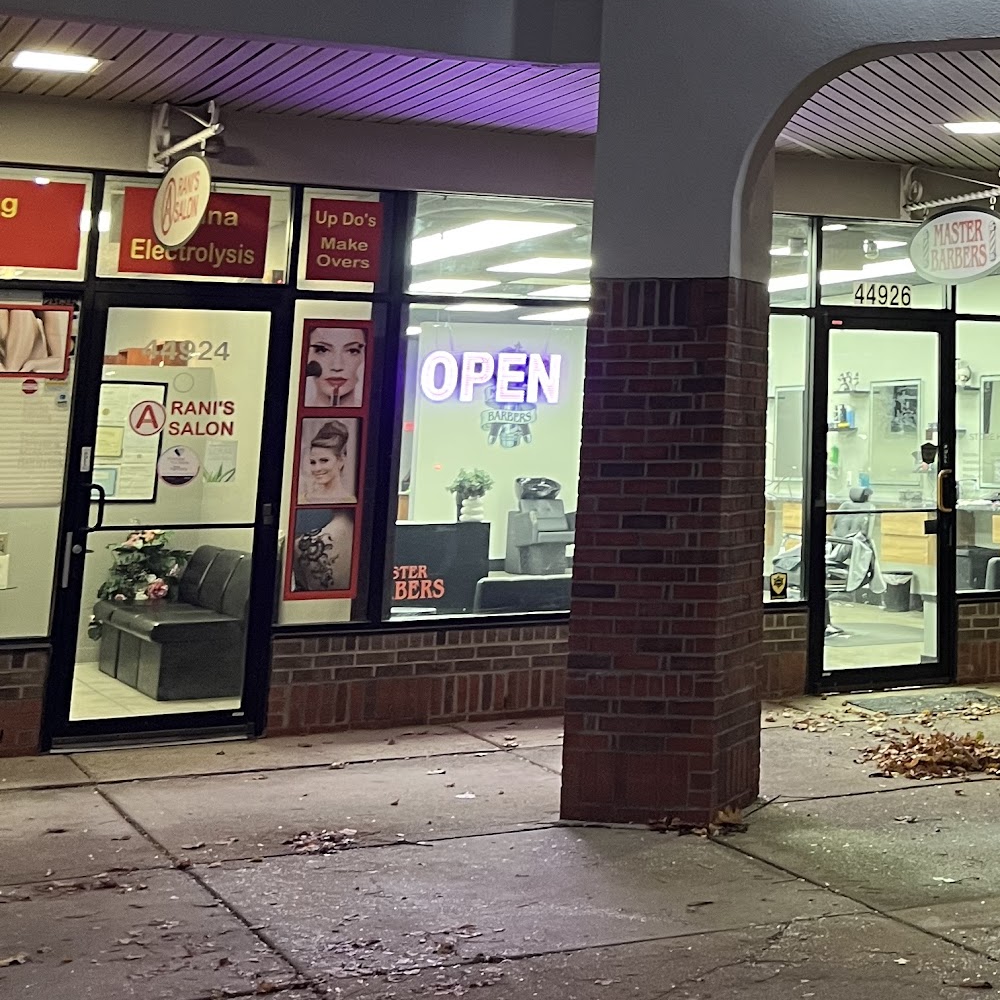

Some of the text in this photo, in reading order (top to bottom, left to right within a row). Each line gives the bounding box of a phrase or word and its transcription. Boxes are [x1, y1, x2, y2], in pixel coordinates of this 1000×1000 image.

[174, 194, 200, 223] SALON
[315, 210, 377, 228] Up Do's
[934, 219, 984, 246] MASTER
[130, 238, 255, 268] Electrolysis
[321, 236, 368, 251] Make
[316, 254, 370, 269] Overs
[931, 244, 988, 271] BARBERS
[855, 283, 911, 306] 44926
[143, 339, 230, 361] 44924
[420, 350, 562, 404] OPEN
[171, 401, 235, 416] RANI'S
[488, 411, 532, 423] BARBERS
[168, 421, 234, 436] SALON
[392, 565, 428, 580] STER
[393, 579, 445, 600] BERS
